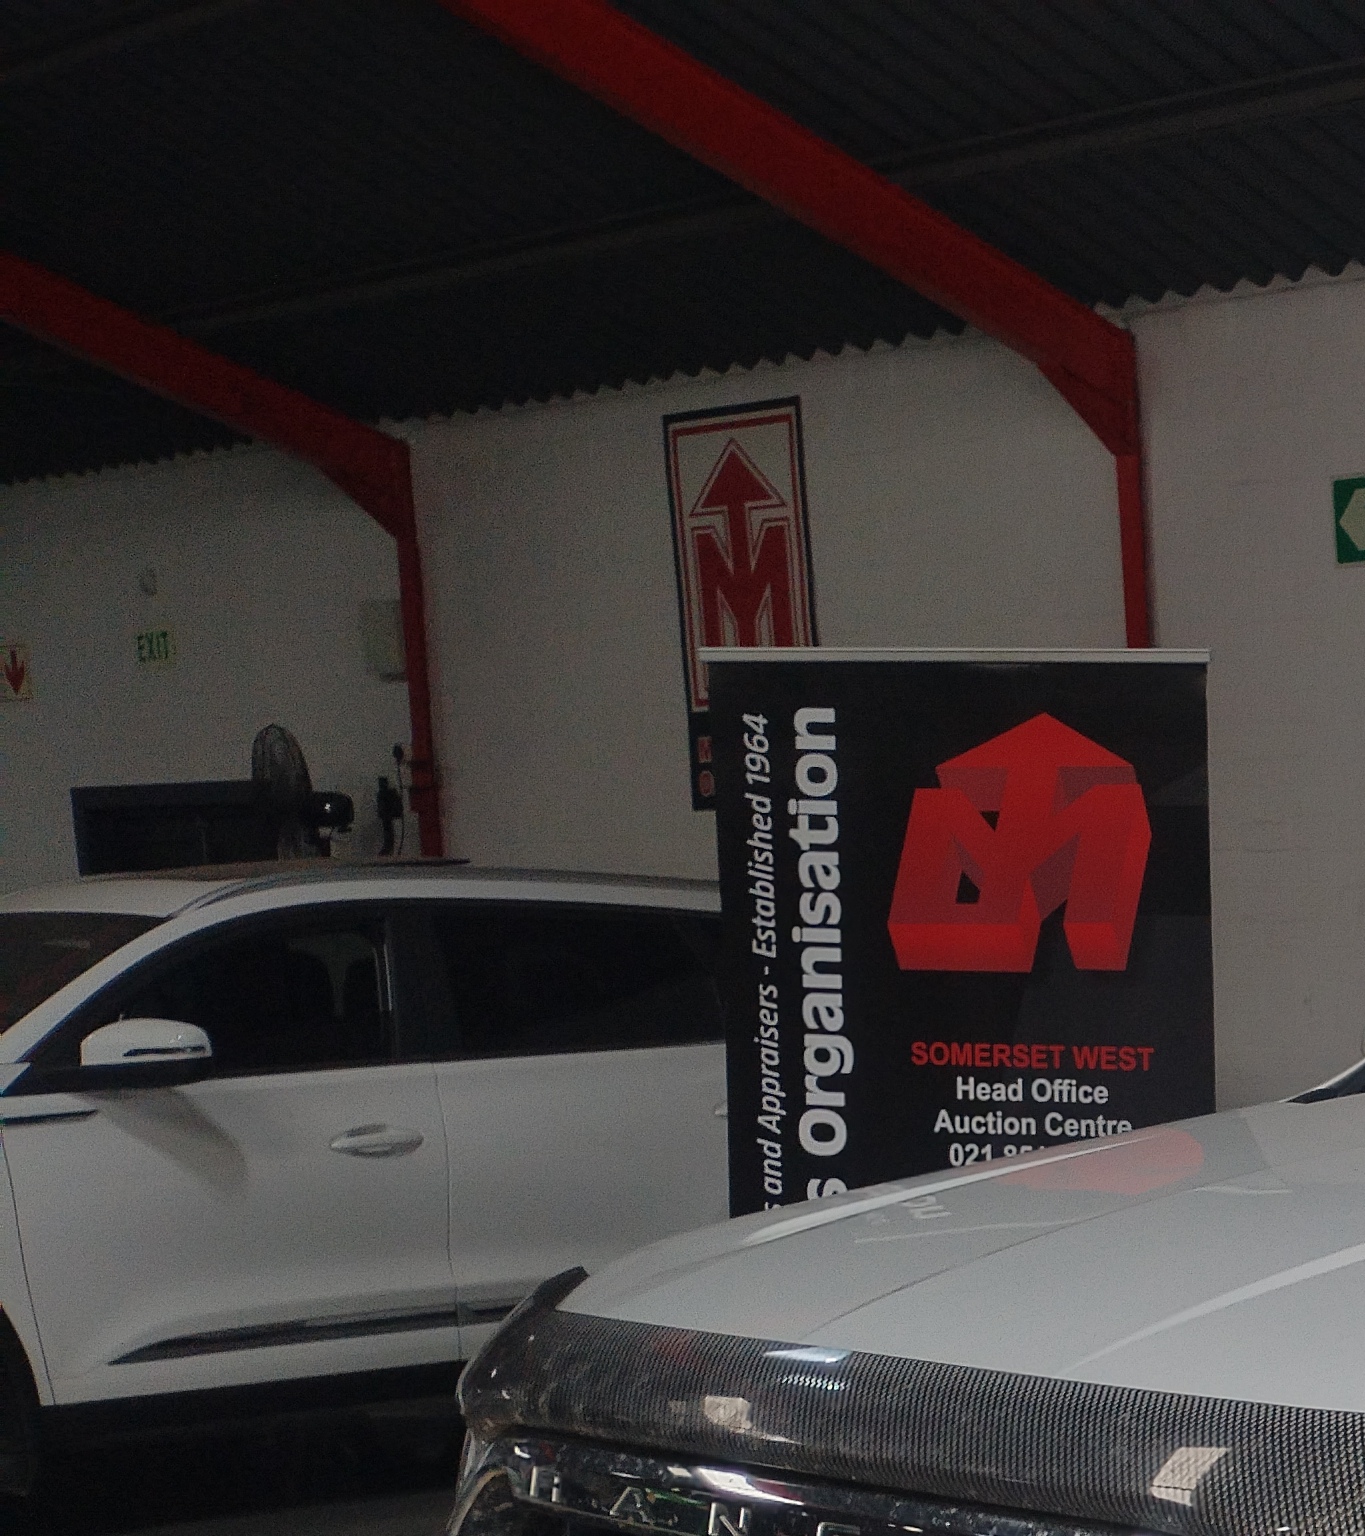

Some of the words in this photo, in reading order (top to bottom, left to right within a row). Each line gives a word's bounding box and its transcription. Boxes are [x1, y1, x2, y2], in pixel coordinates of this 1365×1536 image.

[135, 631, 168, 662] EXIT
[742, 712, 771, 784] 1964
[744, 793, 777, 959] Established
[787, 706, 855, 1157] Organisation
[753, 983, 787, 1134] Appraisers
[911, 1041, 1066, 1069] SOMERSET
[1072, 1045, 1155, 1071] WEST
[956, 1076, 1024, 1101] Head
[1031, 1077, 1109, 1104] Office
[934, 1108, 1037, 1135] Auction
[1044, 1112, 1133, 1138] Centre
[756, 1137, 784, 1196] and
[950, 1143, 994, 1167] 021
